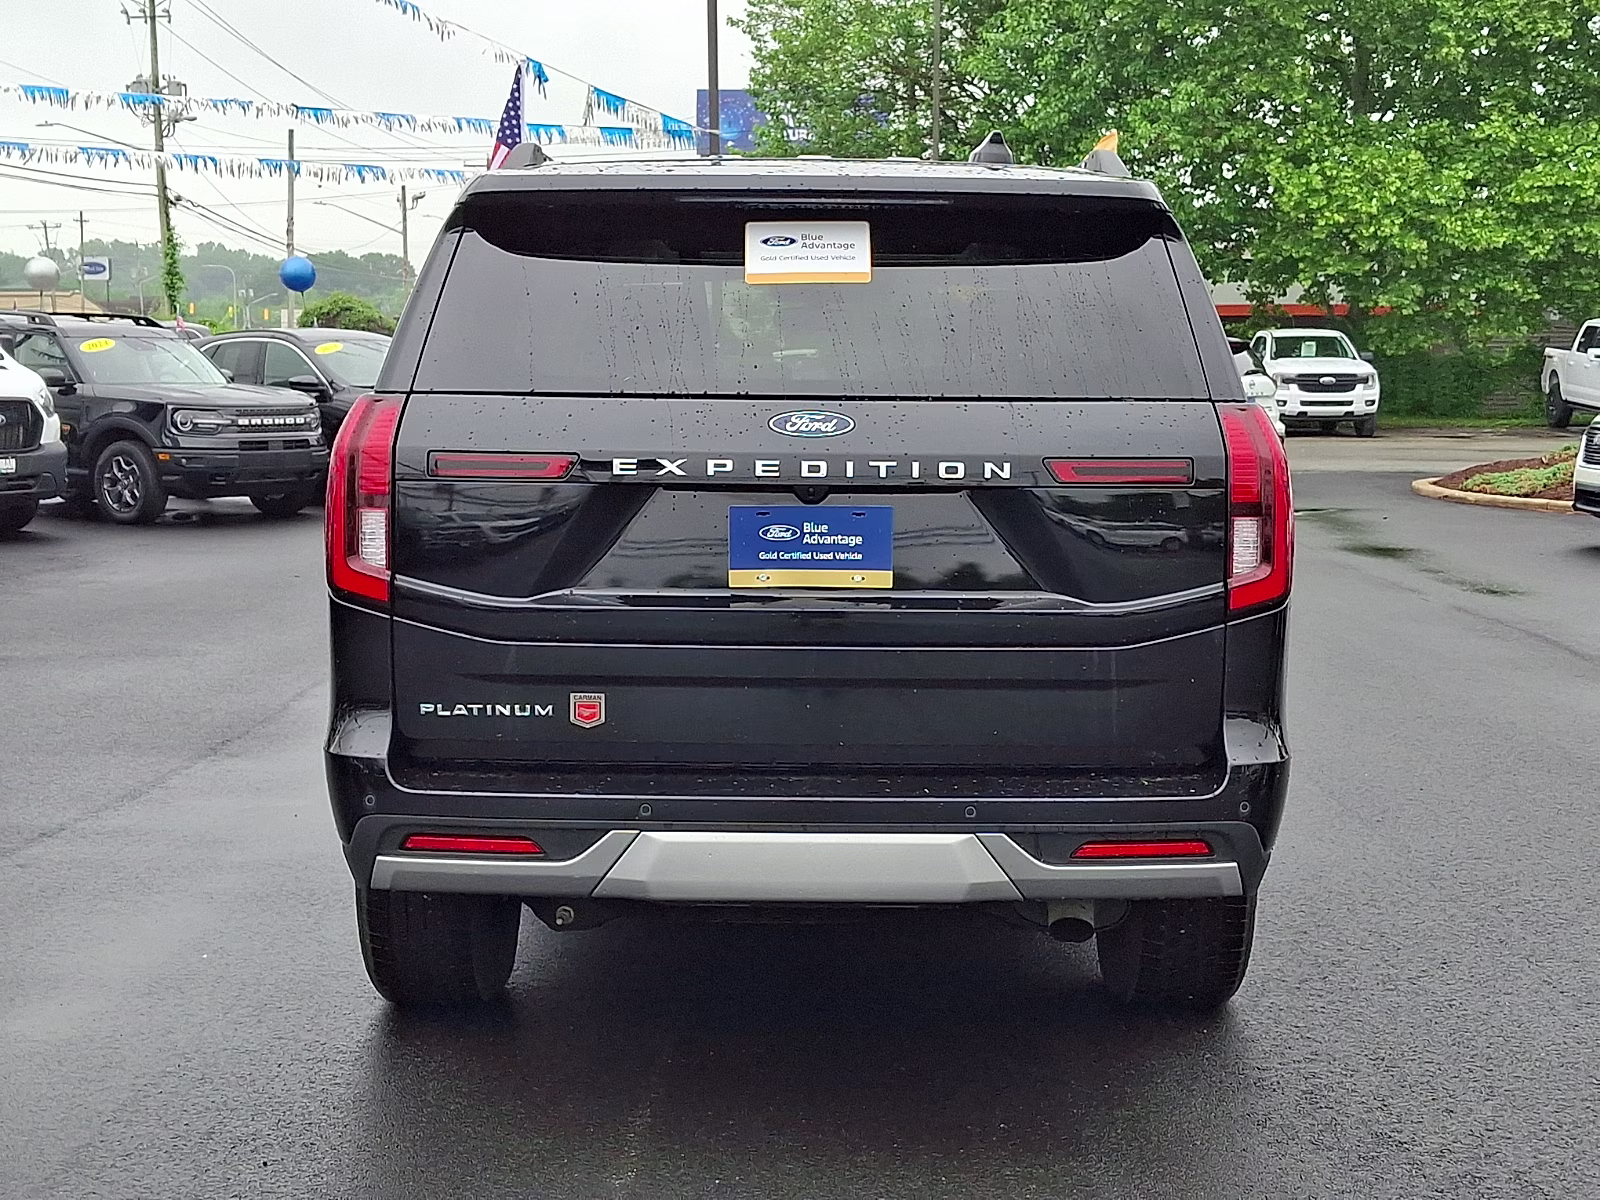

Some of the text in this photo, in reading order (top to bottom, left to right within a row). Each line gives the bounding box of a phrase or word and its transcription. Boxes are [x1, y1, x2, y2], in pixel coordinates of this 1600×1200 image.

[801, 233, 824, 241] Blue
[801, 241, 856, 251] Advantage
[237, 417, 305, 426] BRONCO
[785, 414, 838, 432] Ford
[611, 457, 1012, 480] EXPEDITION
[766, 527, 793, 539] Ford
[803, 521, 829, 533] Blue
[802, 534, 863, 547] Advantage
[758, 551, 863, 561] Gold Certified Used Vehicle
[419, 703, 554, 717] PLATINUM
